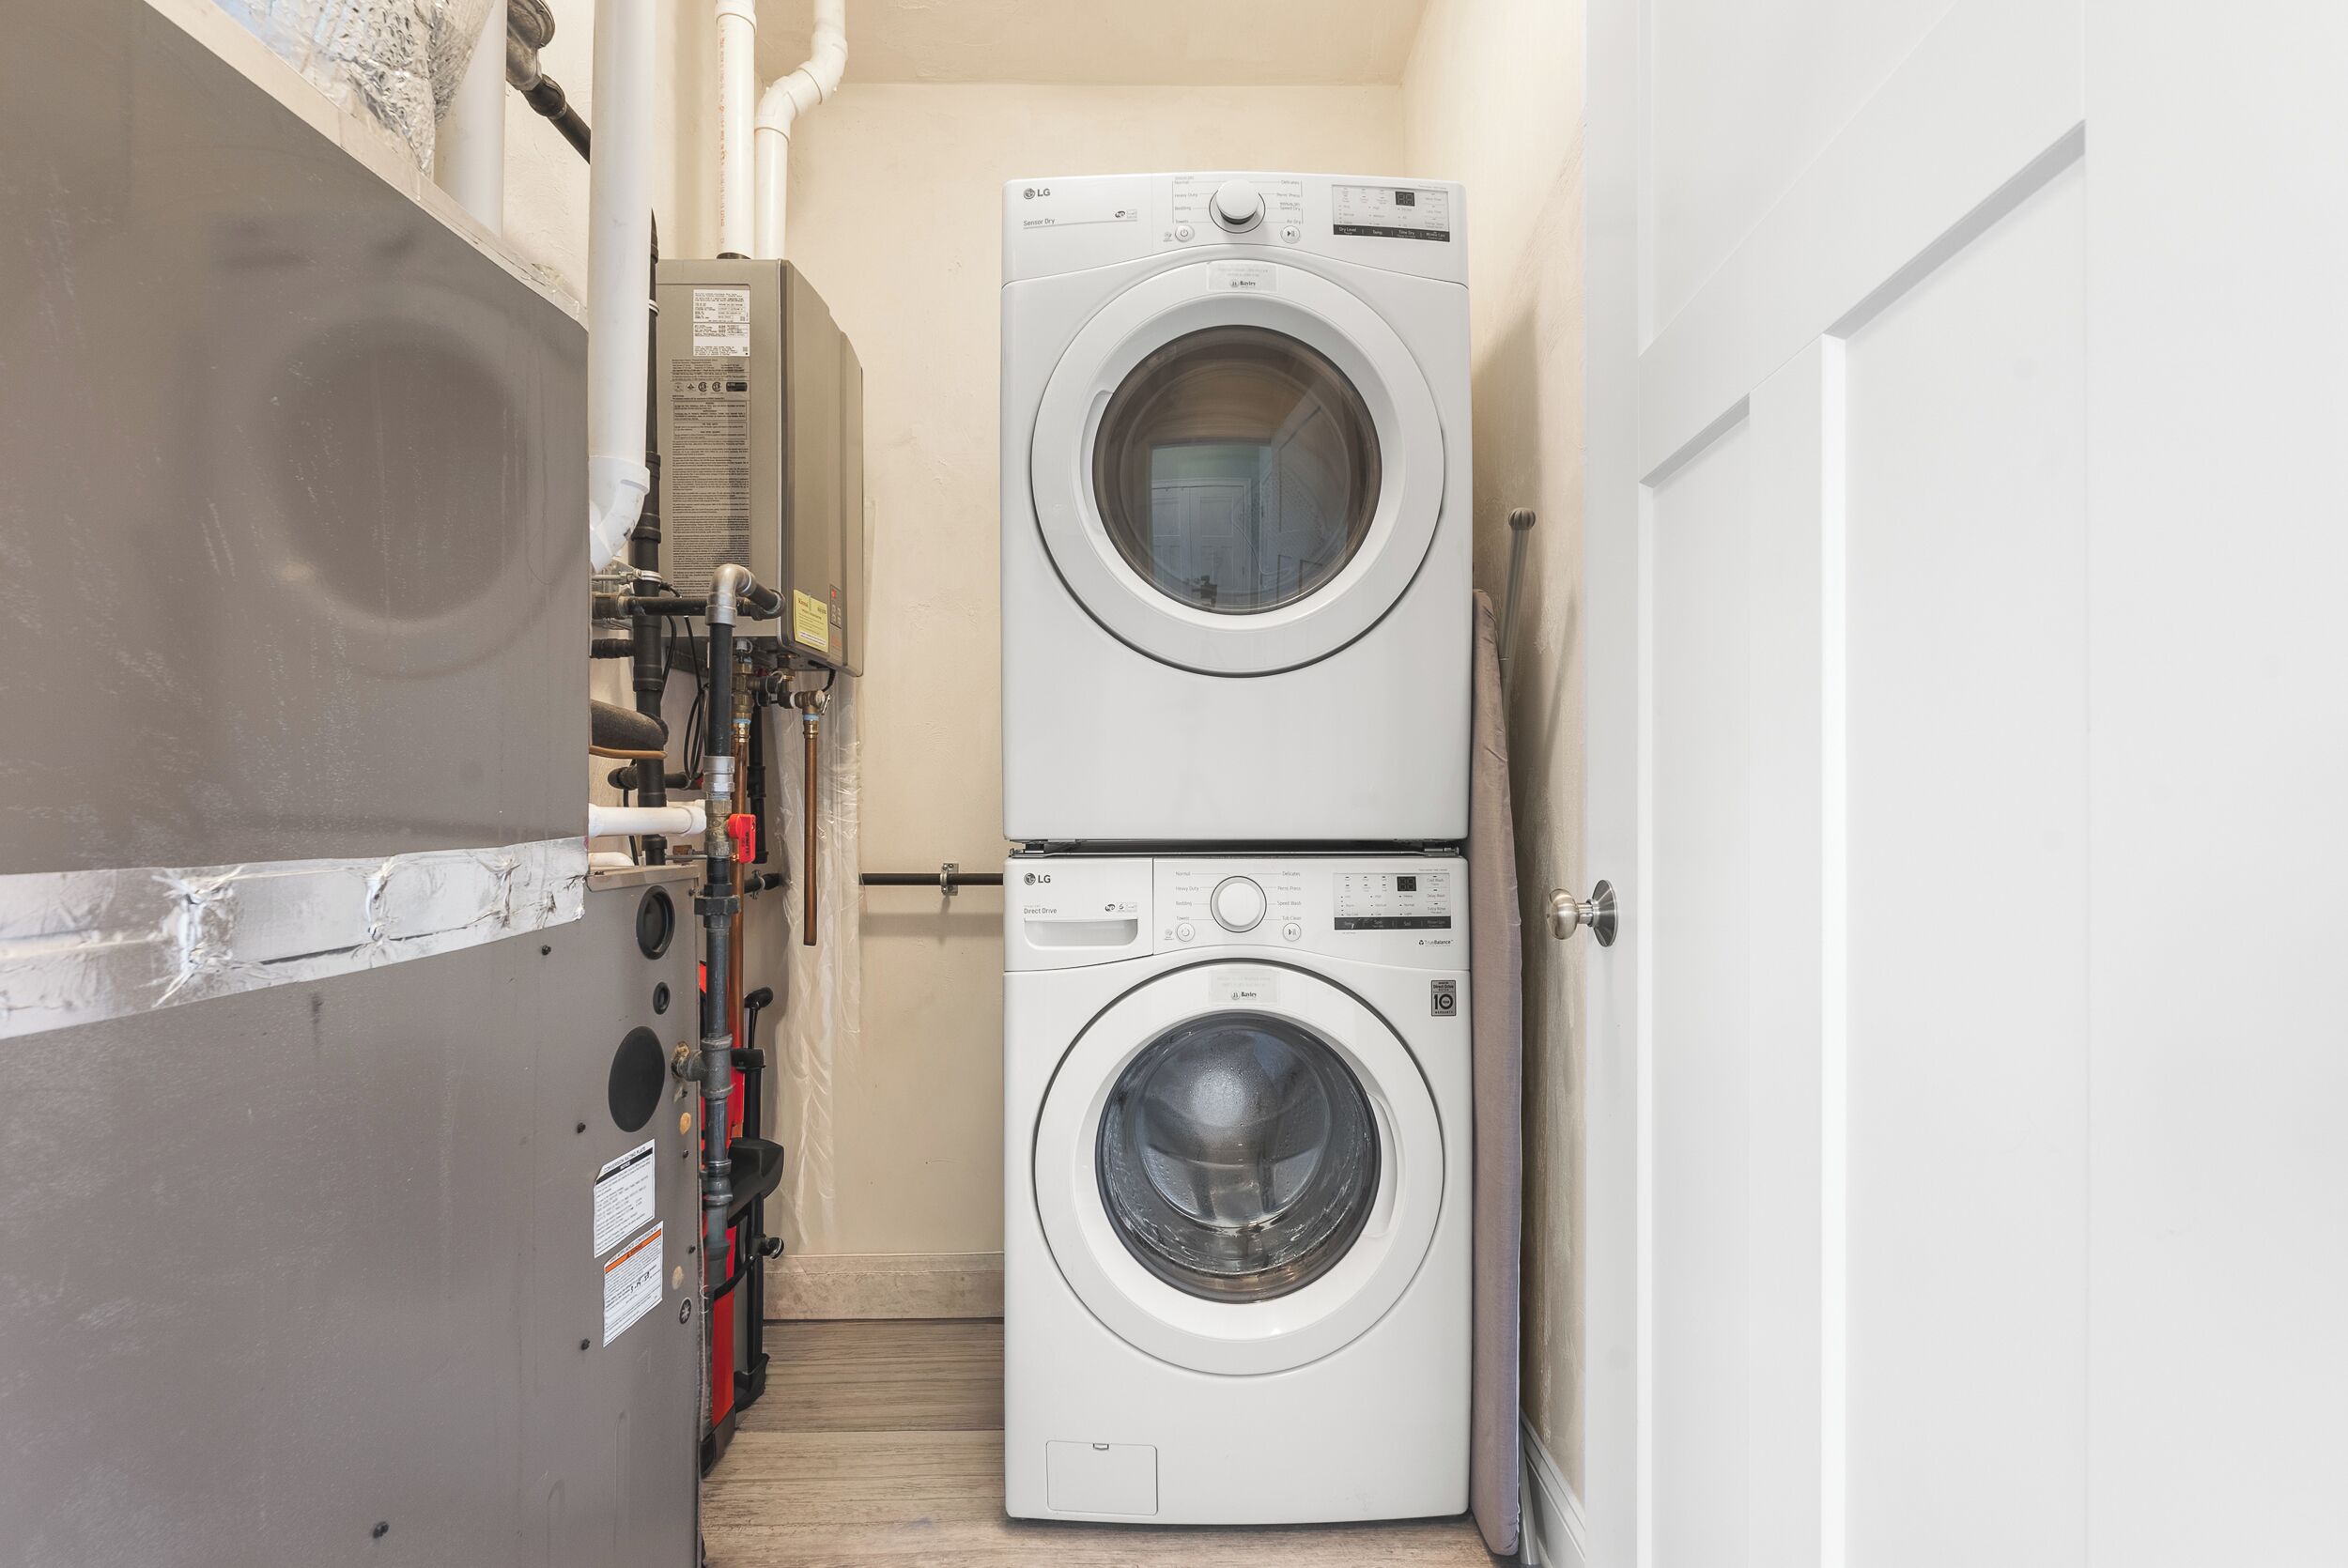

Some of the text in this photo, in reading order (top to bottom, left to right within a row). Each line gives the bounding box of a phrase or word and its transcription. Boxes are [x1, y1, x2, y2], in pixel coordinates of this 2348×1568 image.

[1037, 188, 1051, 197] LG
[1043, 218, 1056, 226] Dry
[1037, 874, 1051, 884] LG
[1433, 993, 1454, 1010] 10
[636, 1146, 646, 1155] PLATE
